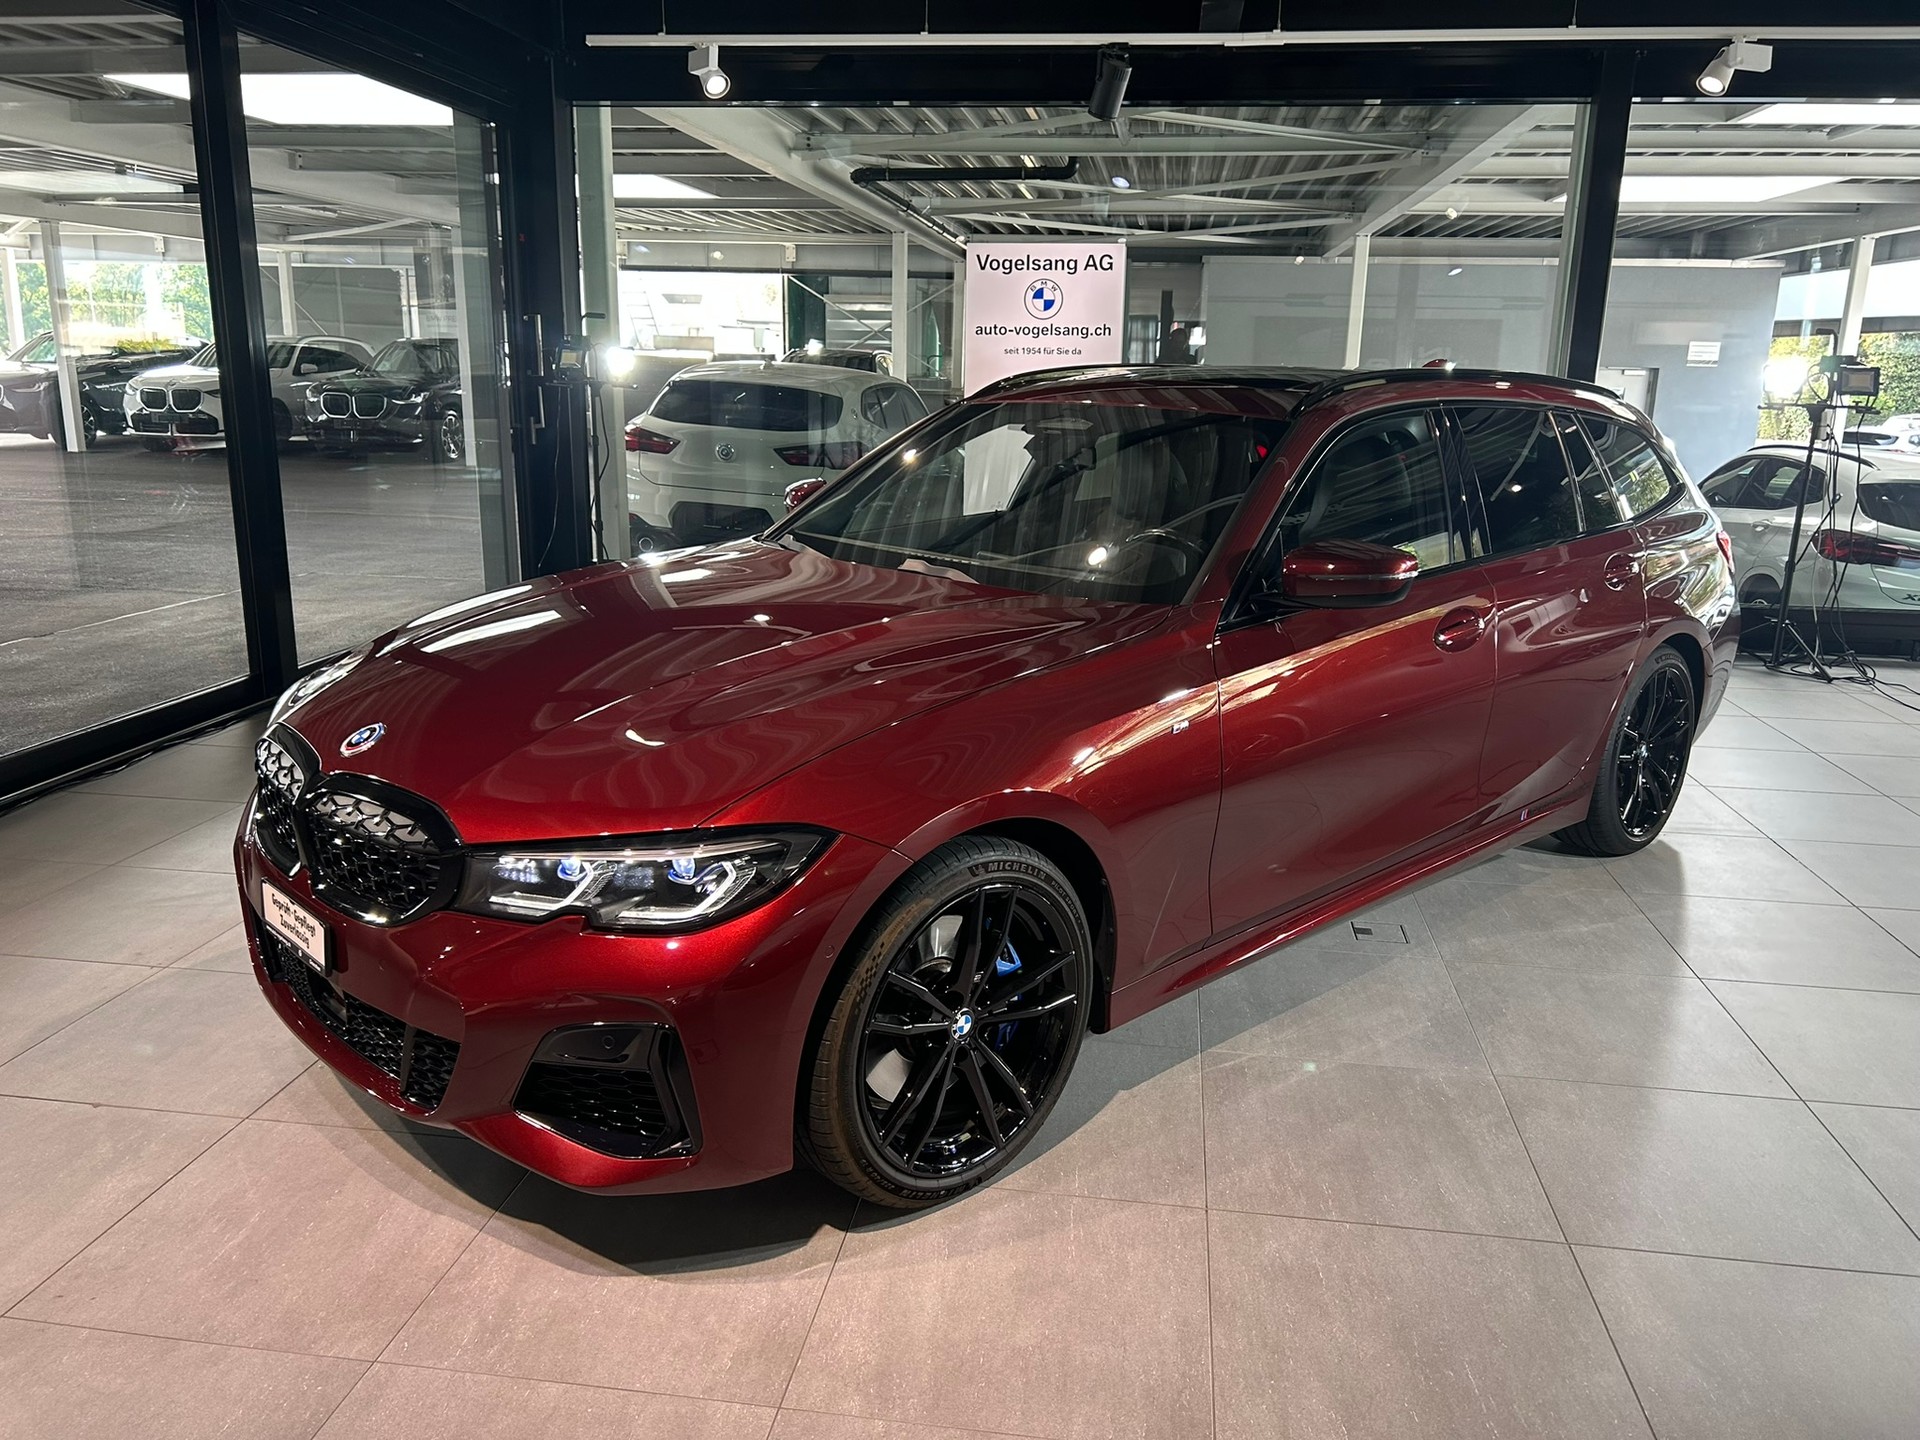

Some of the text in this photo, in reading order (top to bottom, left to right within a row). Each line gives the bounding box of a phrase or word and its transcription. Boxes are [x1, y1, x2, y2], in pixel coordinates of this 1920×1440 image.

[976, 253, 1114, 275] Vogelsang AG
[1030, 281, 1058, 292] BMW
[975, 323, 1112, 339] auto-vogelsang.ch
[1004, 347, 1082, 355] seit 1954 für Sie da
[988, 861, 1047, 880] MICHELIN
[1051, 880, 1080, 919] PILOT SPORT
